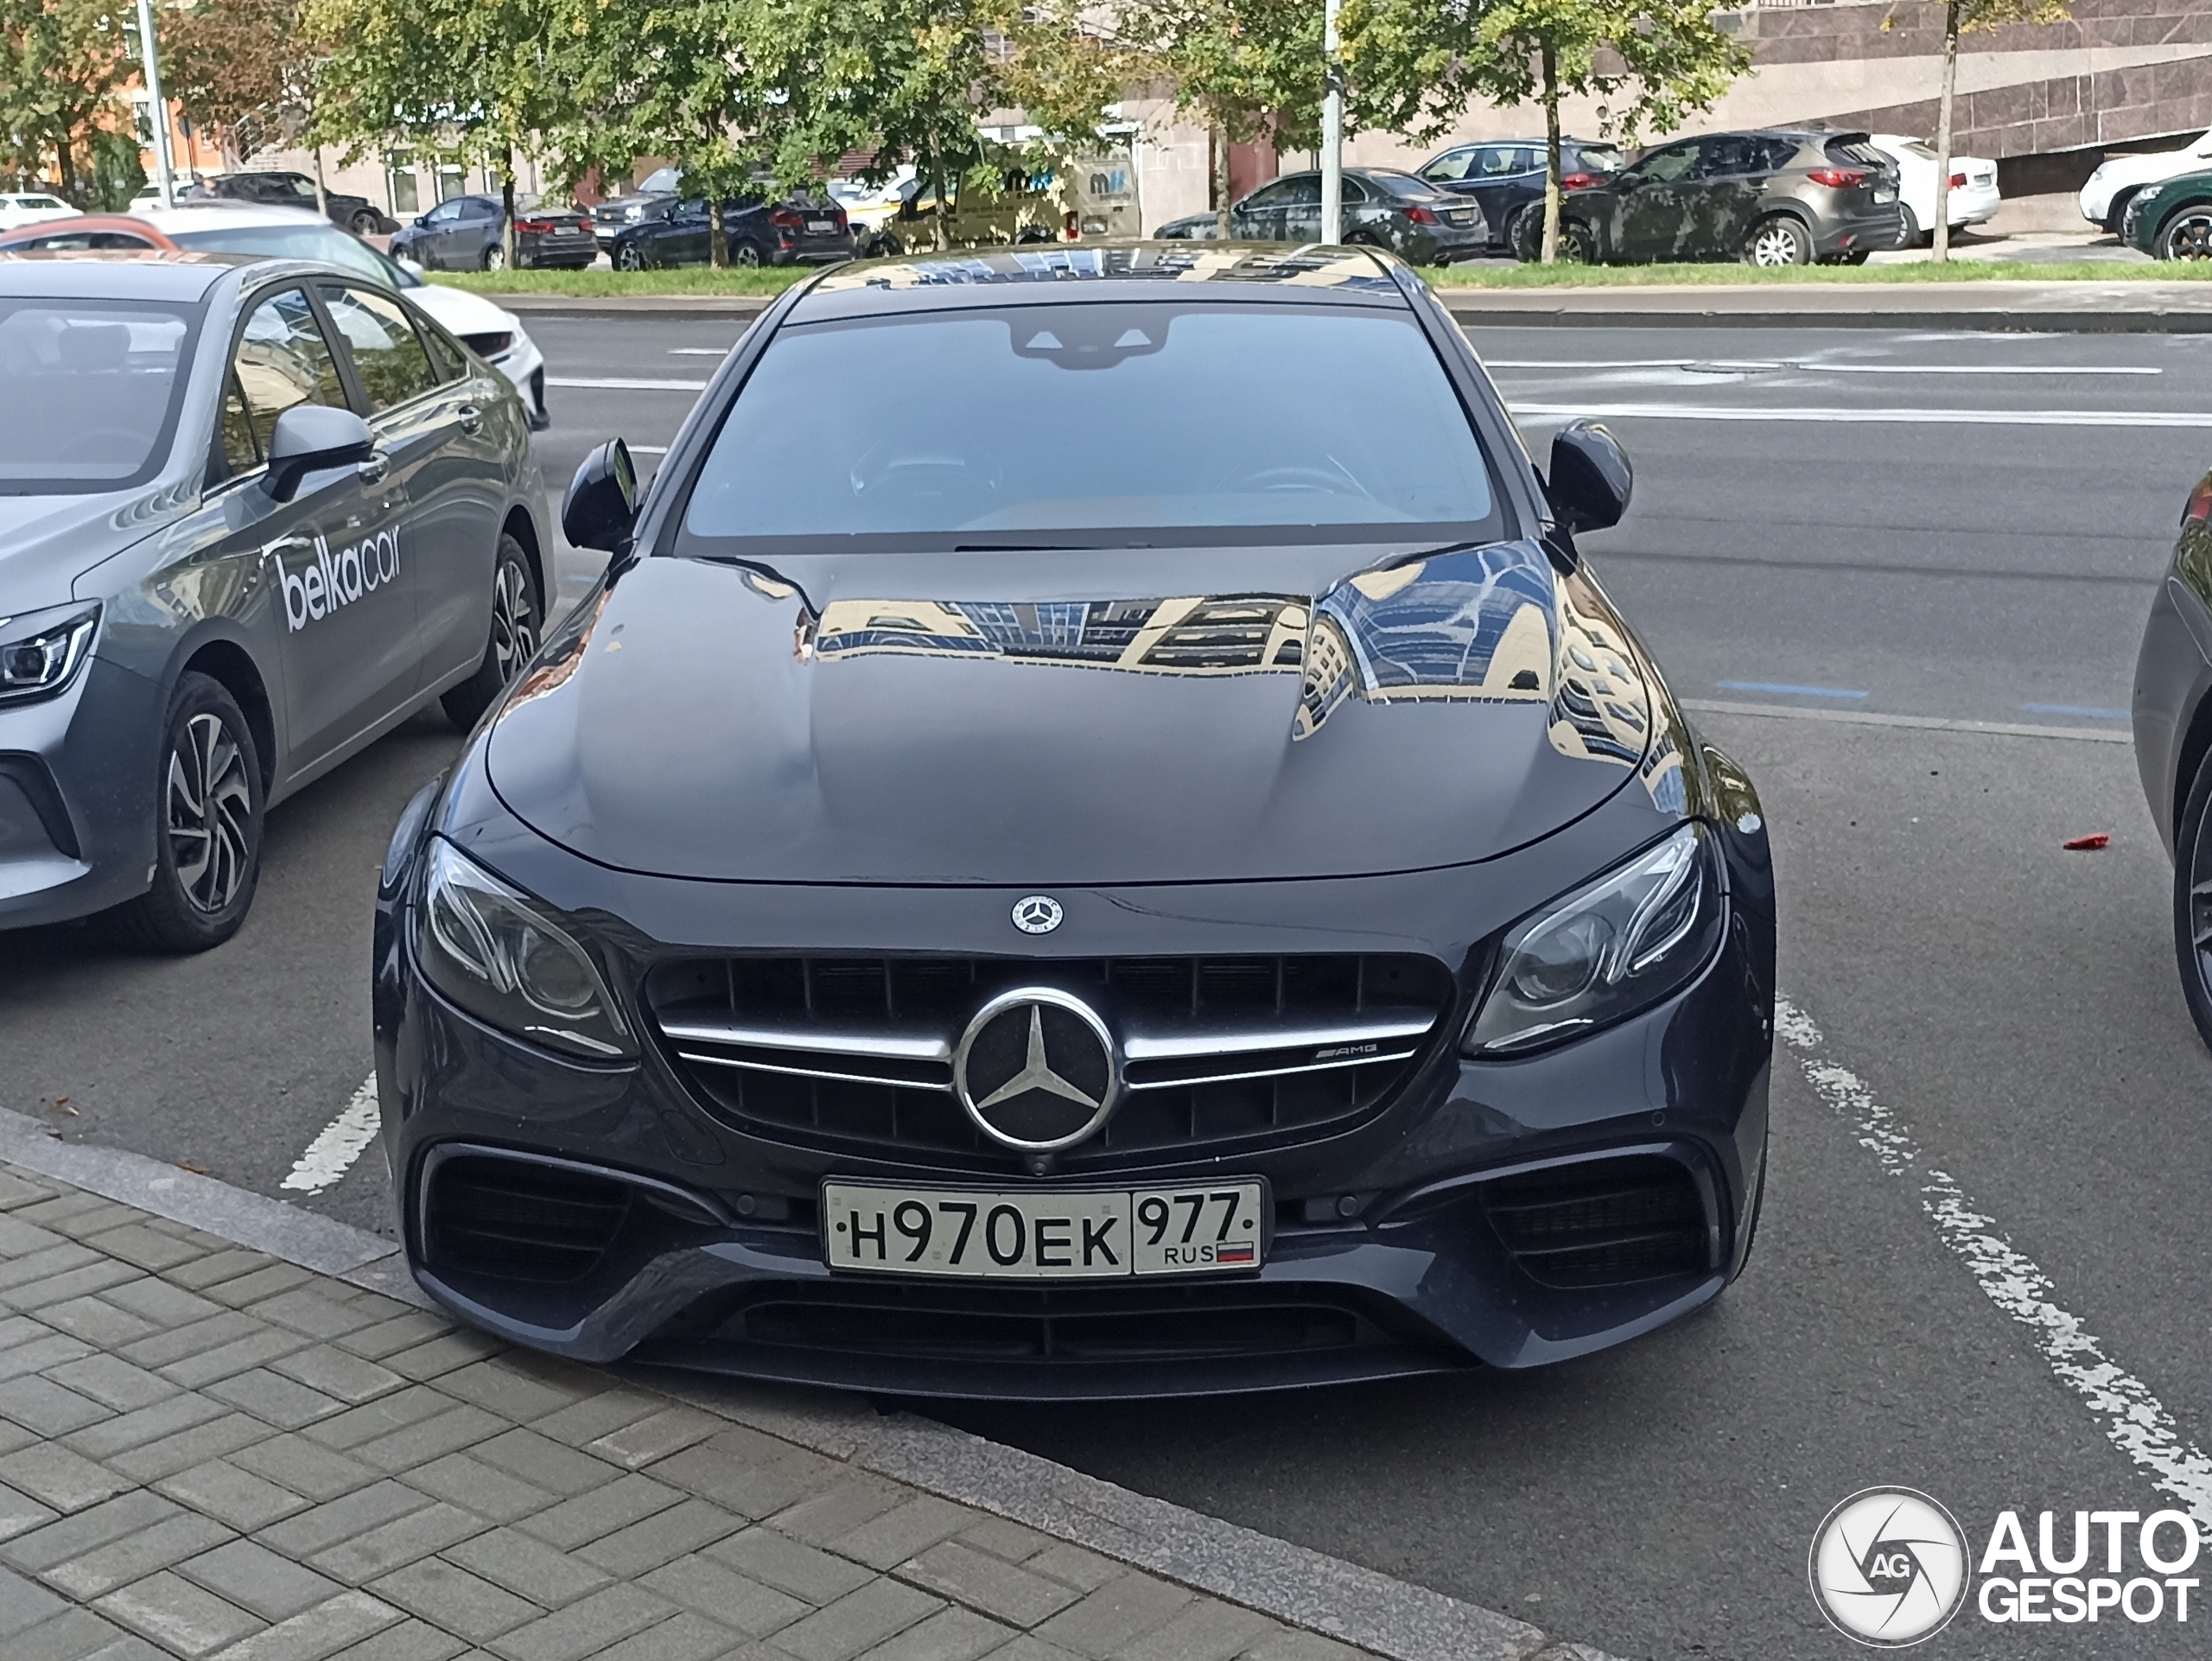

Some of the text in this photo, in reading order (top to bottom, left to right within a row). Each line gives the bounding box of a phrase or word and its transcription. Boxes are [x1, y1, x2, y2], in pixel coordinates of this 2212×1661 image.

[275, 525, 400, 633] belkacar
[1335, 1043, 1377, 1056] AMG
[1138, 1192, 1240, 1245] 977
[1164, 1246, 1214, 1264] RUS
